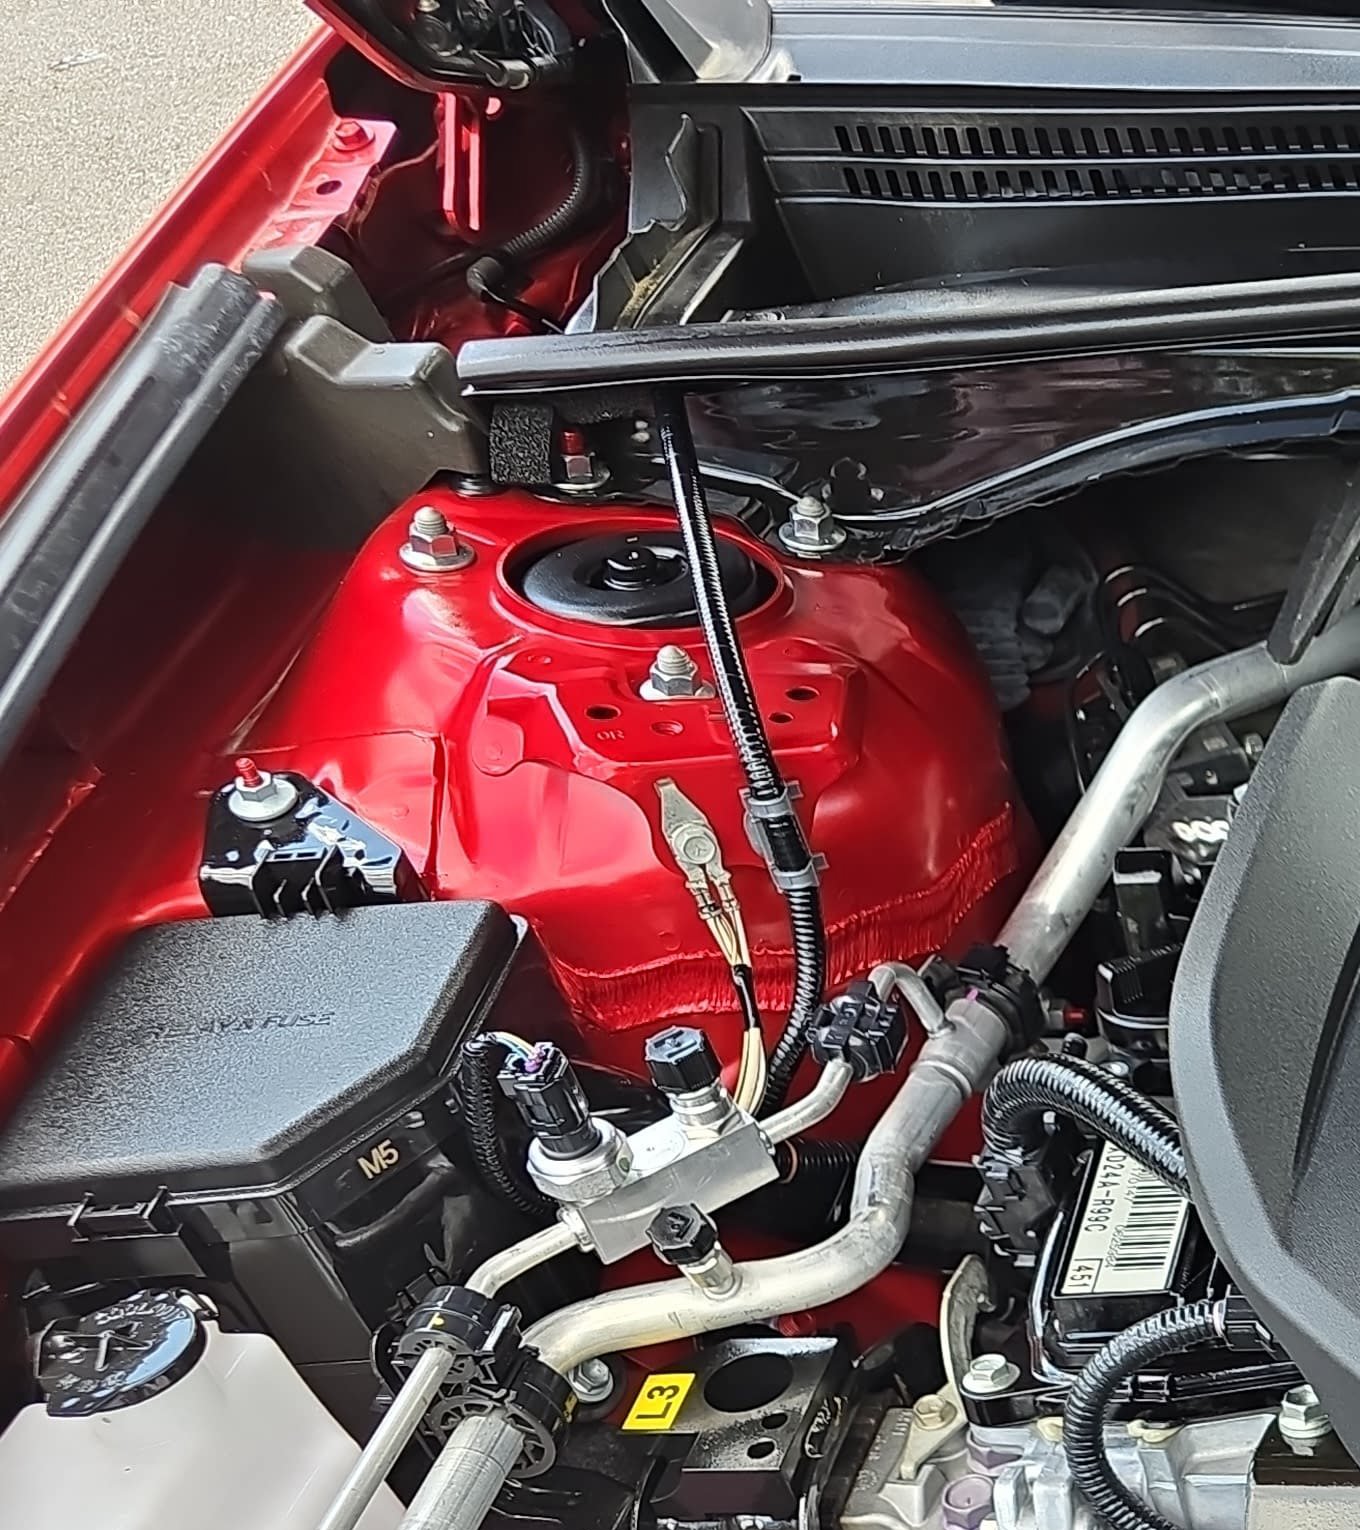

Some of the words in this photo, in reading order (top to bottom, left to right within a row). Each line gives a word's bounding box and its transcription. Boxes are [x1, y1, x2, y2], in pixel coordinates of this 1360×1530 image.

[357, 1139, 399, 1179] M5
[1067, 1264, 1094, 1287] 451
[635, 1385, 680, 1419] L3
